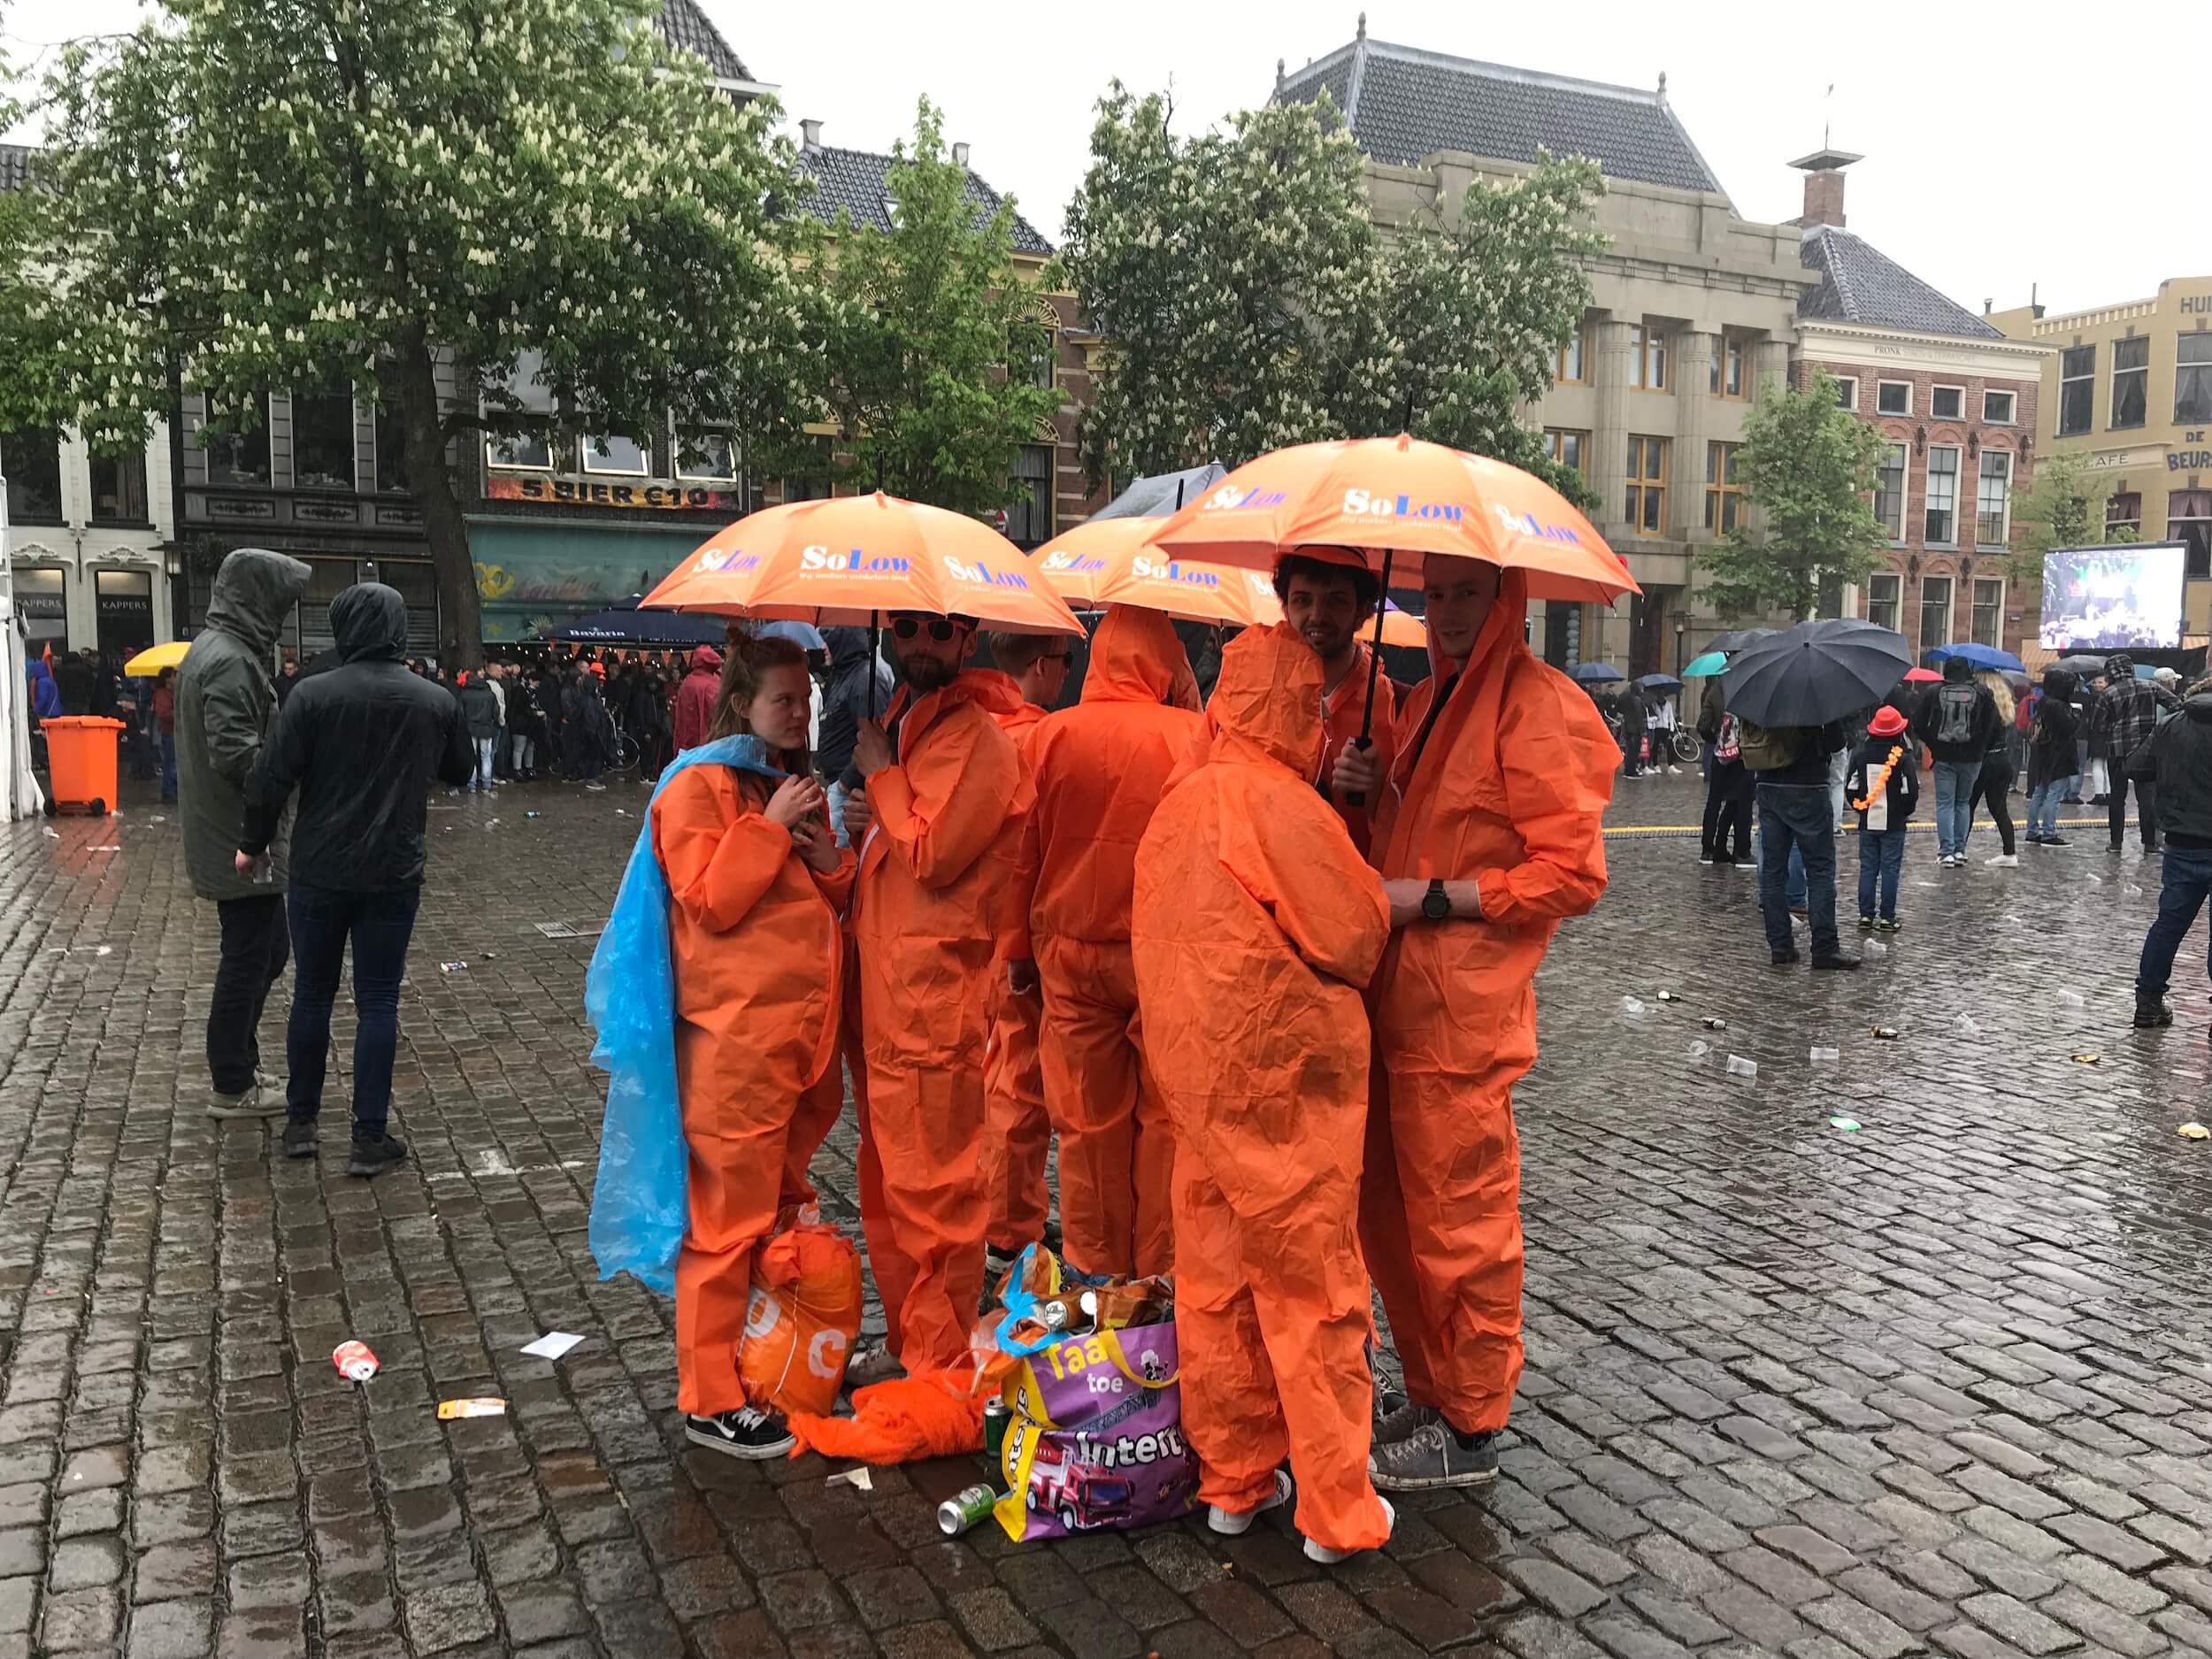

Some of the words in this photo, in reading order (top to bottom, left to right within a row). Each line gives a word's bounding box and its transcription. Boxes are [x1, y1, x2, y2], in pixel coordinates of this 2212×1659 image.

[1874, 345, 1901, 355] PRONK
[2186, 431, 2205, 442] DE
[2093, 453, 2130, 467] AFE
[2167, 450, 2212, 472] BEUR
[522, 479, 543, 498] 5
[554, 480, 634, 504] BIER
[1342, 488, 1469, 522] SoLow
[799, 544, 912, 572] SoLow
[102, 600, 148, 611] KAPPERS
[568, 628, 626, 638] Bavaria
[1087, 1373, 1124, 1394] toe
[1075, 1425, 1186, 1468] Intert
